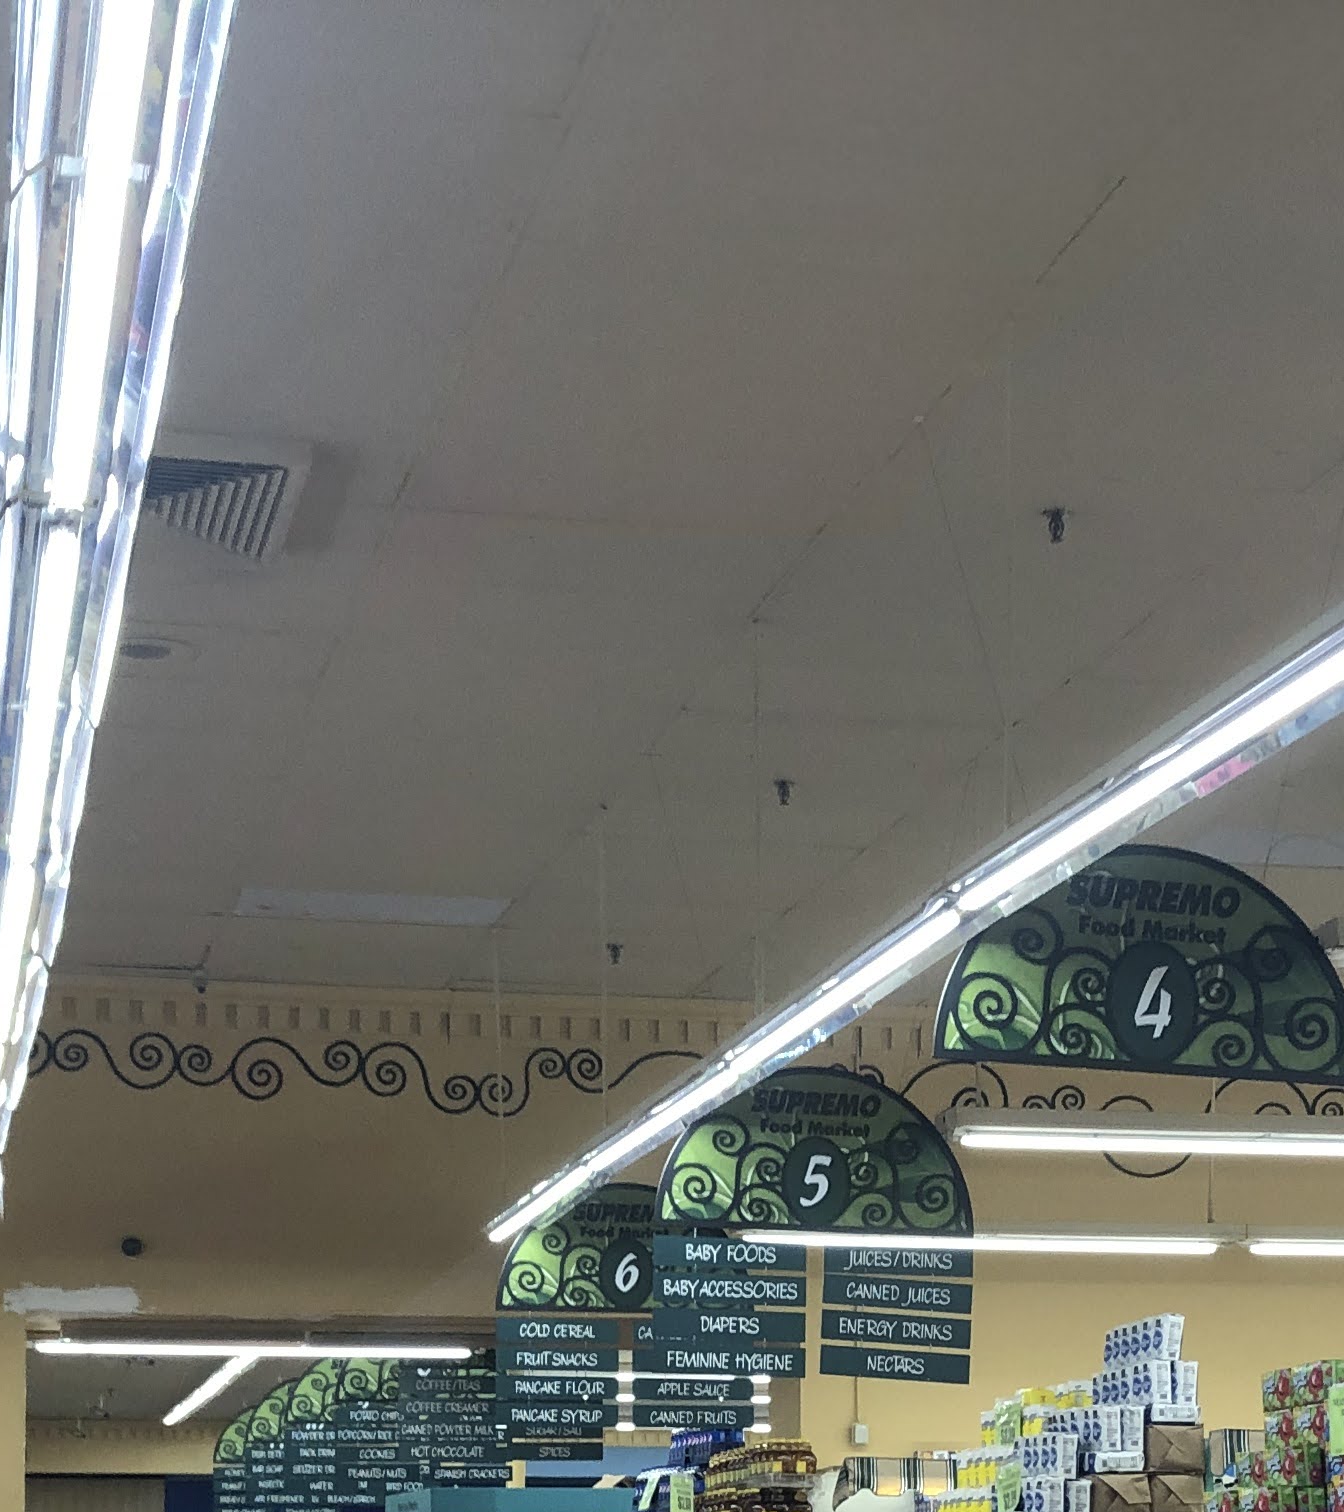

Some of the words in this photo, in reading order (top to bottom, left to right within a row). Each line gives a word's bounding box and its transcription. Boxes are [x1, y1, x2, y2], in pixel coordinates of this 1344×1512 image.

[1066, 874, 1241, 919] SUPREMO
[1079, 916, 1135, 938] Food
[1141, 920, 1226, 944] Market
[1135, 966, 1172, 1039] 4
[752, 1088, 881, 1119] SUPREMO
[760, 1118, 802, 1136] Food
[800, 1154, 832, 1207] 5
[685, 1244, 720, 1261] BABY
[727, 1245, 777, 1264] FOODS
[615, 1252, 639, 1293] 6
[663, 1279, 698, 1297] BABY
[699, 1280, 798, 1300] ACCESSORIES
[847, 1283, 900, 1301] CANNED
[902, 1287, 951, 1306] JUICES
[520, 1323, 550, 1338] COLD
[554, 1323, 595, 1338] CEREAL
[700, 1316, 760, 1334] DIAPERS
[839, 1318, 898, 1338] ENERGY
[902, 1322, 953, 1340] DRINKS
[517, 1352, 551, 1367] FRUIT
[553, 1352, 597, 1367] SNACKS
[667, 1351, 730, 1369] FEMININE
[735, 1353, 793, 1371] HYGIENE
[867, 1355, 924, 1373] NECTARS
[515, 1381, 560, 1394] PANCAKE
[566, 1383, 604, 1395] FLOUR
[657, 1382, 691, 1396] APPLE
[693, 1383, 730, 1397] SAUCE
[406, 1402, 442, 1413] COFFEE
[445, 1403, 489, 1413] CREAMER
[511, 1408, 558, 1423] PANCAKE
[561, 1409, 602, 1424] SYRUP
[650, 1410, 693, 1424] CANNED
[697, 1411, 737, 1424] FRUITS
[474, 1425, 494, 1435] MILK
[411, 1446, 429, 1457] HOT
[431, 1446, 484, 1458] CHOCOLATE
[539, 1448, 570, 1458] SPICES
[469, 1469, 510, 1479] CRACKERS
